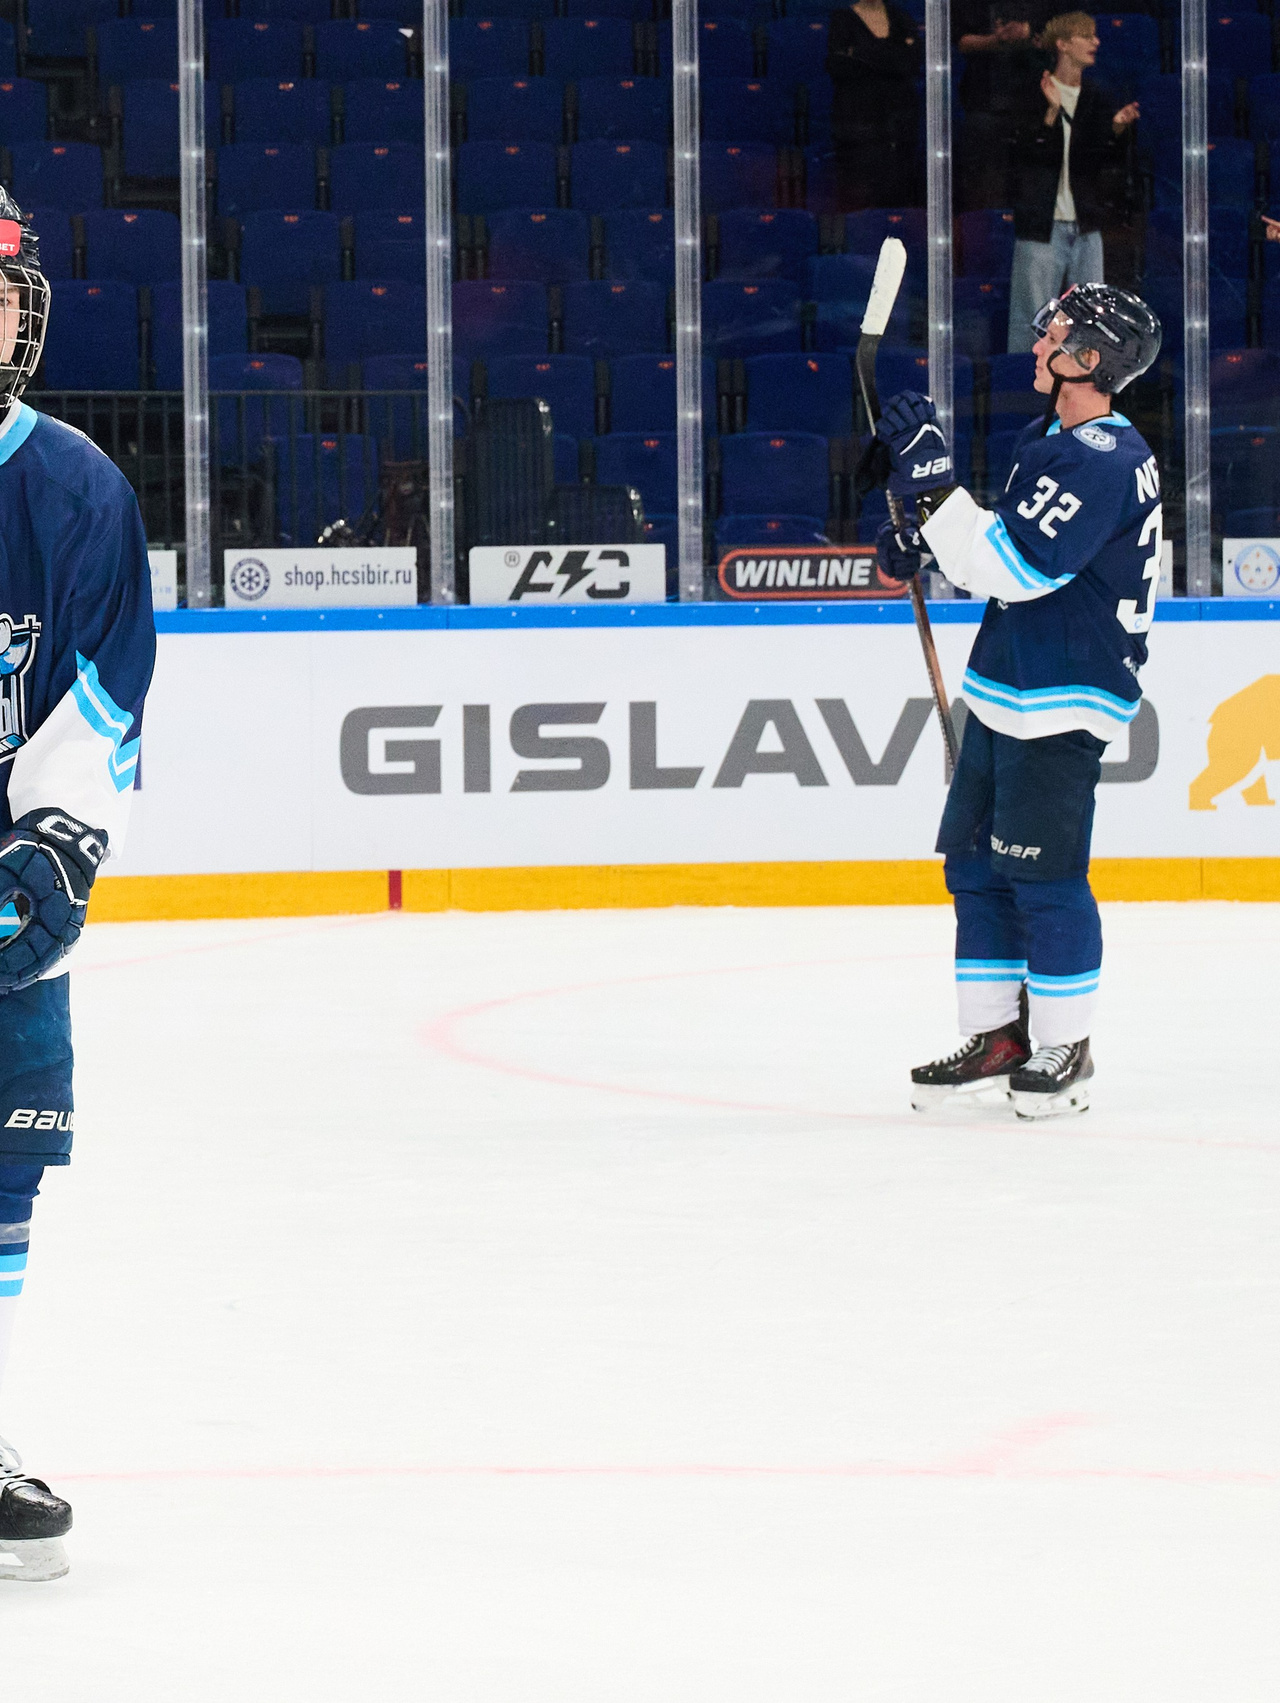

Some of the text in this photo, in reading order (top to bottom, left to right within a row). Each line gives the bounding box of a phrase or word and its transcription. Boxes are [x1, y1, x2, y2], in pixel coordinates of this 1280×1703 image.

[1016, 475, 1083, 539] 32
[284, 563, 413, 591] shop.hcsibir.ru
[735, 558, 873, 588] WINLINE
[339, 696, 1160, 796] GISLAV
